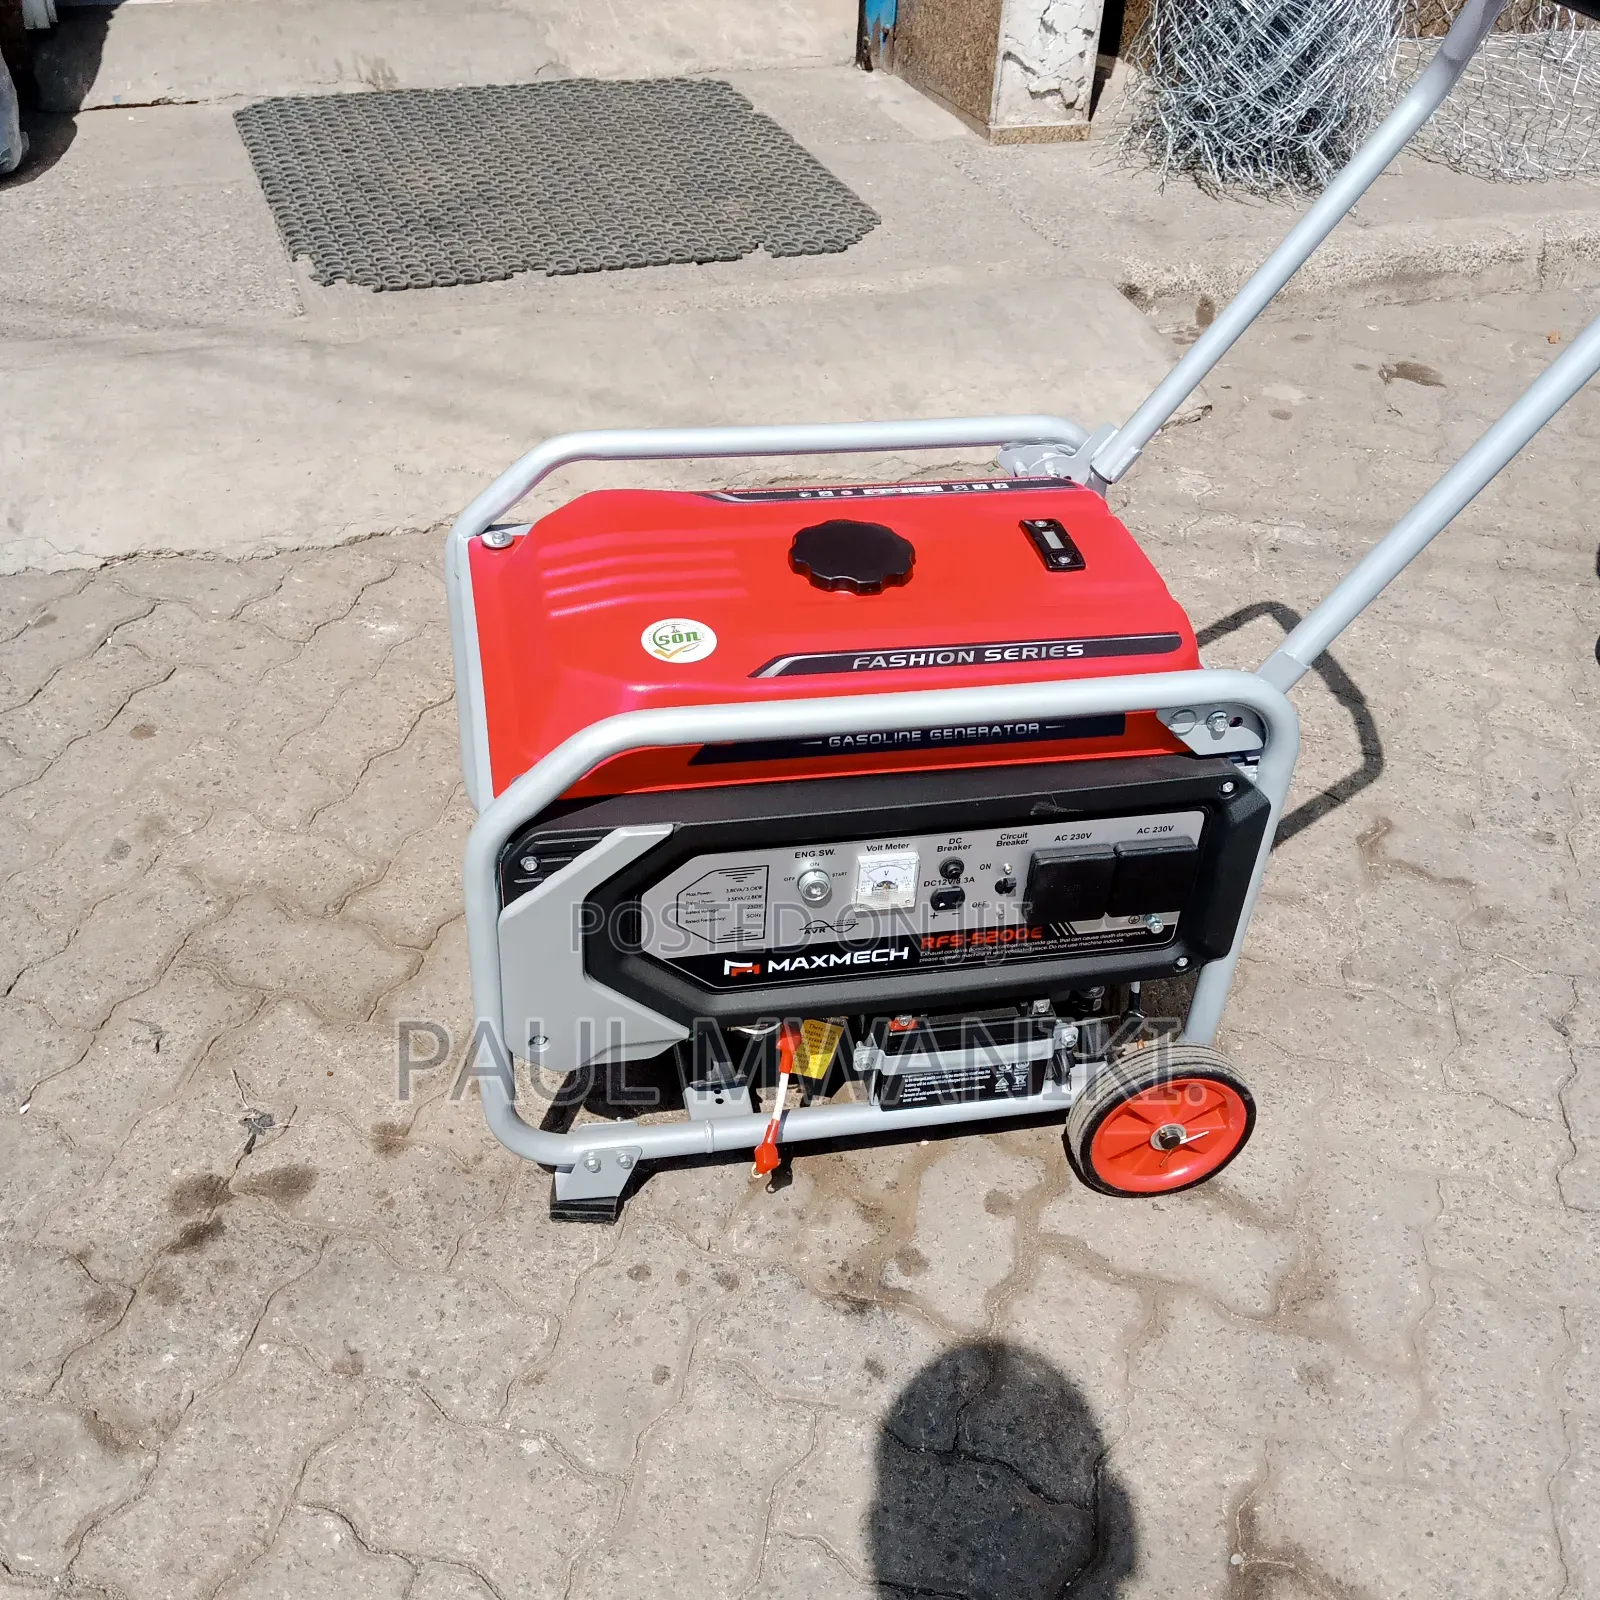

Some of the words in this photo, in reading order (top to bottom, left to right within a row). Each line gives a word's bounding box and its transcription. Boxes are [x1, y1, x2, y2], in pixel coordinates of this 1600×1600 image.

[852, 651, 975, 670] FASHION
[984, 643, 1084, 662] SERIES
[828, 730, 922, 748] GASOLINE
[929, 722, 1040, 741] GENERATOR
[1136, 826, 1151, 835] AC
[1152, 824, 1175, 834] 230V
[948, 837, 963, 845] DC
[999, 831, 1029, 841] Circuit
[1054, 834, 1069, 842] AC
[1070, 832, 1093, 841] 230V
[866, 844, 883, 852] Volt
[885, 842, 910, 851] Meter
[936, 843, 972, 853] Breaker
[996, 839, 1029, 847] Breaker
[979, 863, 992, 871] ON
[971, 900, 987, 909] OFF
[804, 927, 826, 935] AVR
[767, 946, 910, 973] MAXMECH
